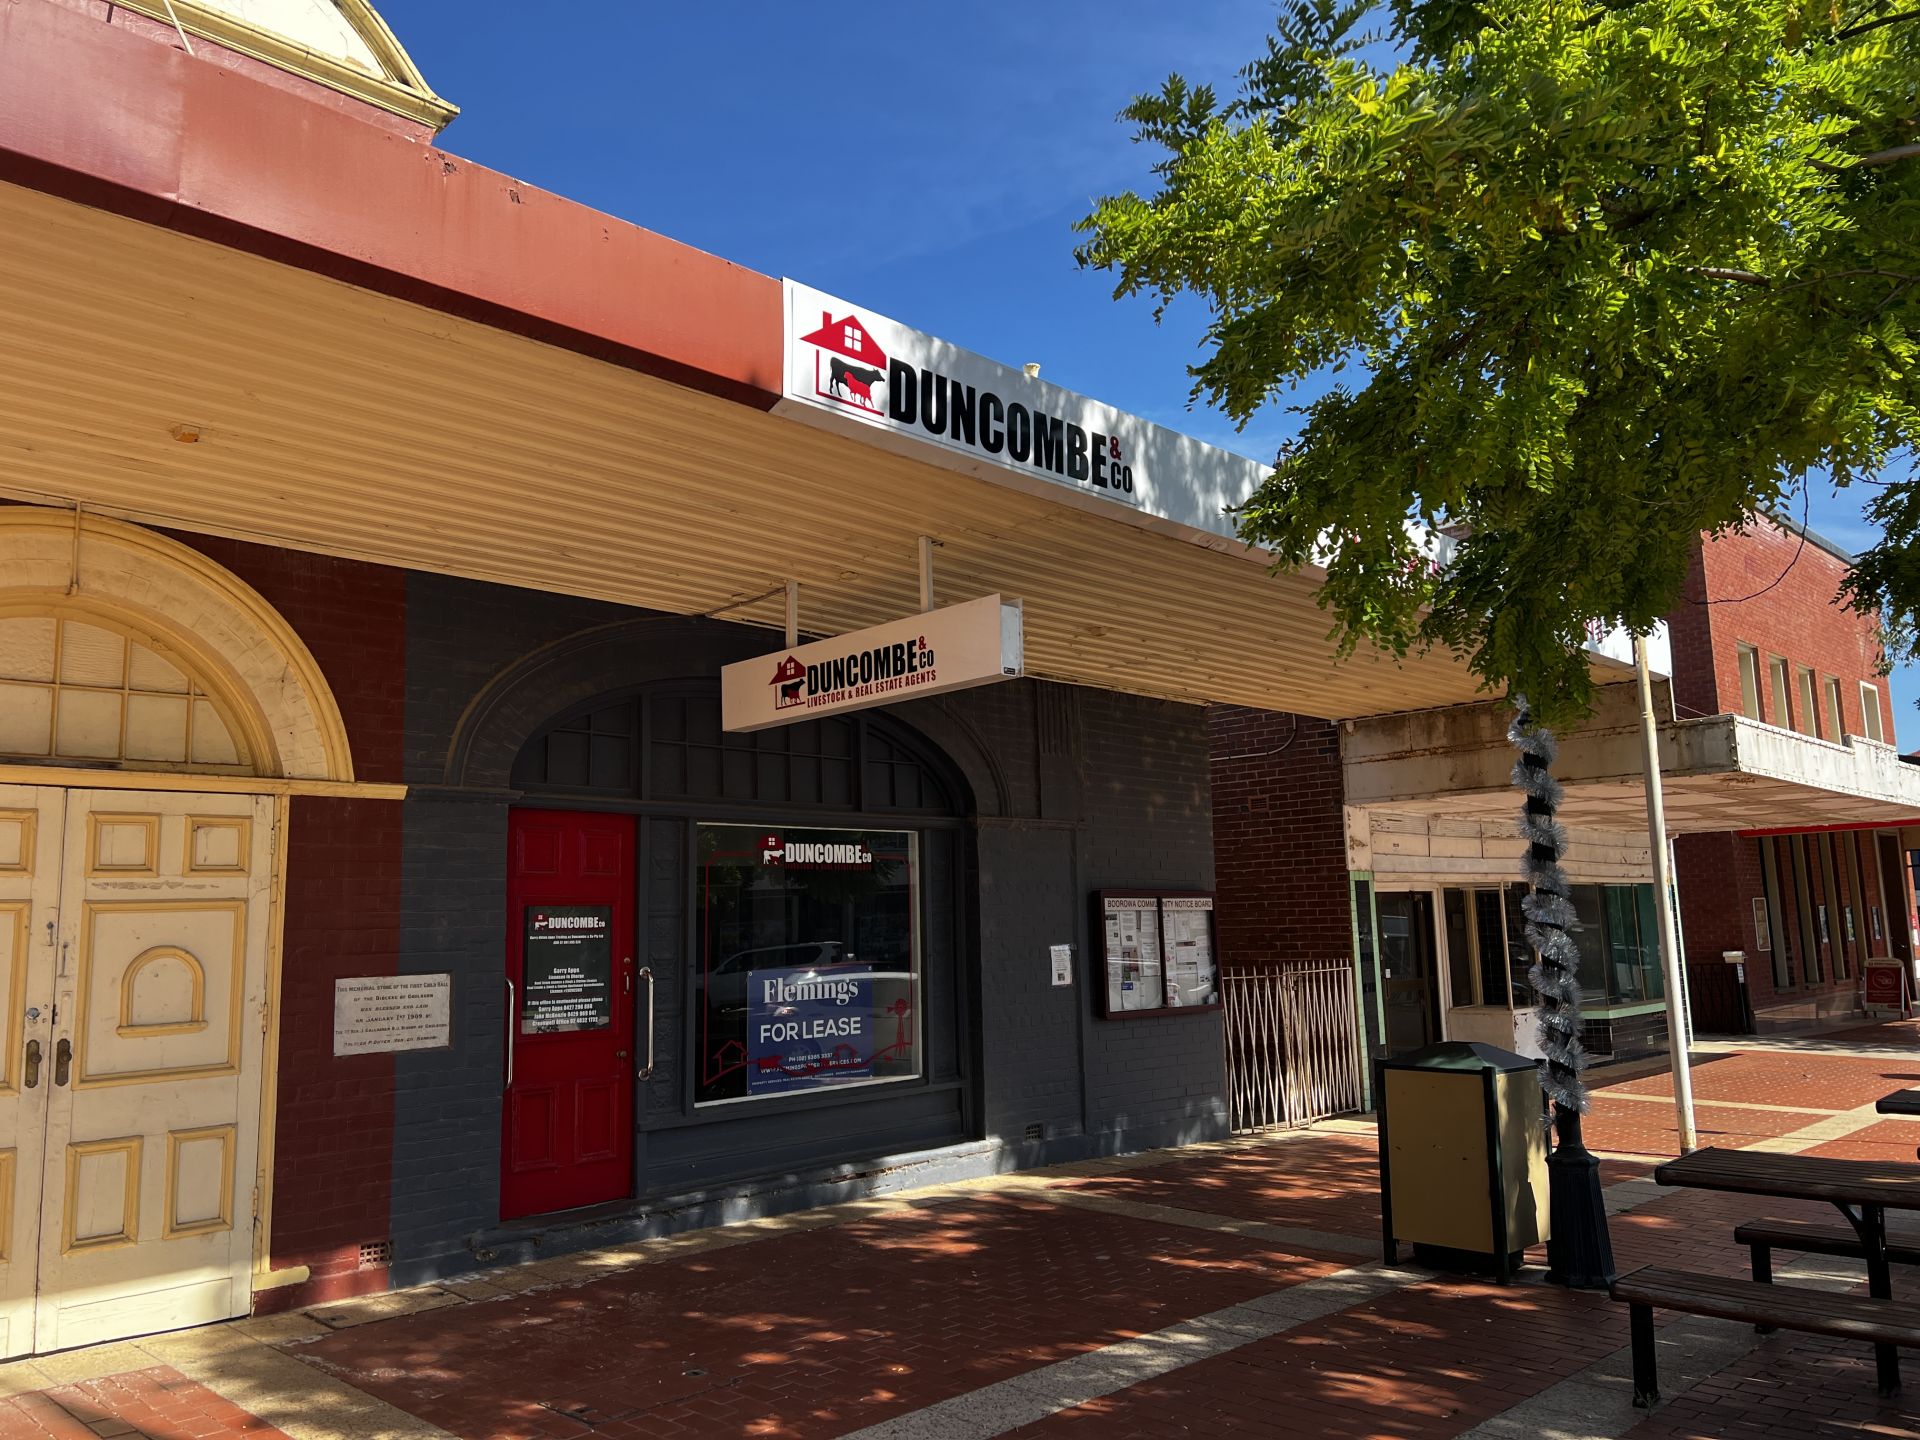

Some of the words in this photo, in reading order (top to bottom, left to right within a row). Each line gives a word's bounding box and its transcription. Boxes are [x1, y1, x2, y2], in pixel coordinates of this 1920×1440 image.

[889, 357, 1108, 488] DUNCOMBE
[1109, 436, 1122, 460] &
[1111, 461, 1133, 494] CO
[918, 635, 927, 650] &
[807, 639, 918, 696] DUNCOMBE
[919, 649, 934, 669] CO
[807, 690, 845, 708] LIVESTOCK
[848, 689, 853, 699] &
[855, 683, 873, 697] REAL
[875, 678, 902, 694] ESTATE
[905, 669, 936, 688] AGENTS
[785, 843, 862, 864] DUNCOMBE
[862, 852, 872, 863] CO
[1174, 900, 1193, 909] NOTICE
[548, 917, 599, 929] DUNCOMBE
[763, 977, 859, 1005] Flemings
[760, 1023, 798, 1043] FOR
[803, 1016, 861, 1039] LEASE
